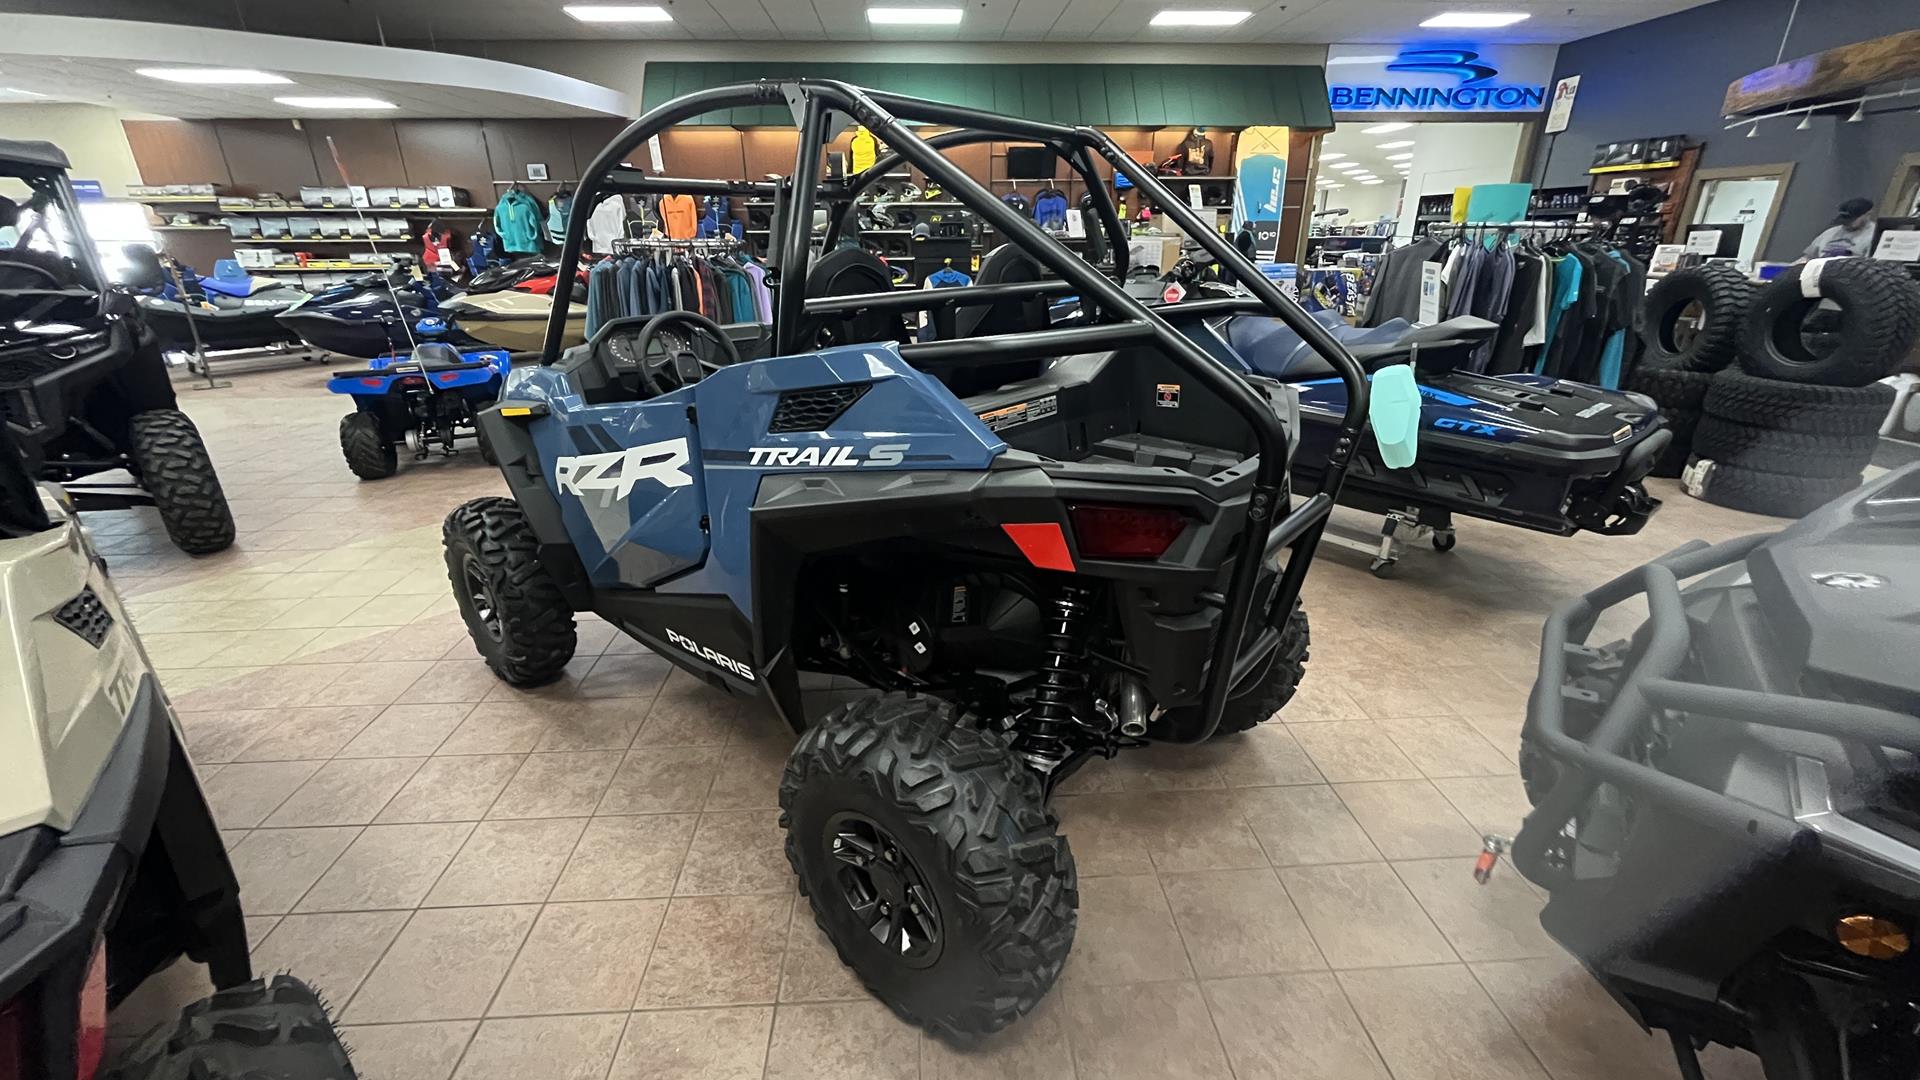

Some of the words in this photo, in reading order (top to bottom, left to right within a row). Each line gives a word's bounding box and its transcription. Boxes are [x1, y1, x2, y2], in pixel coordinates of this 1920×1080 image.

[1331, 87, 1546, 107] BENNINGTON
[1345, 272, 1356, 308] BEAST
[1434, 417, 1502, 437] GTX
[556, 437, 693, 501] RZR
[748, 447, 860, 466] TRAIL
[860, 443, 911, 467] S
[665, 627, 755, 681] POLARIS
